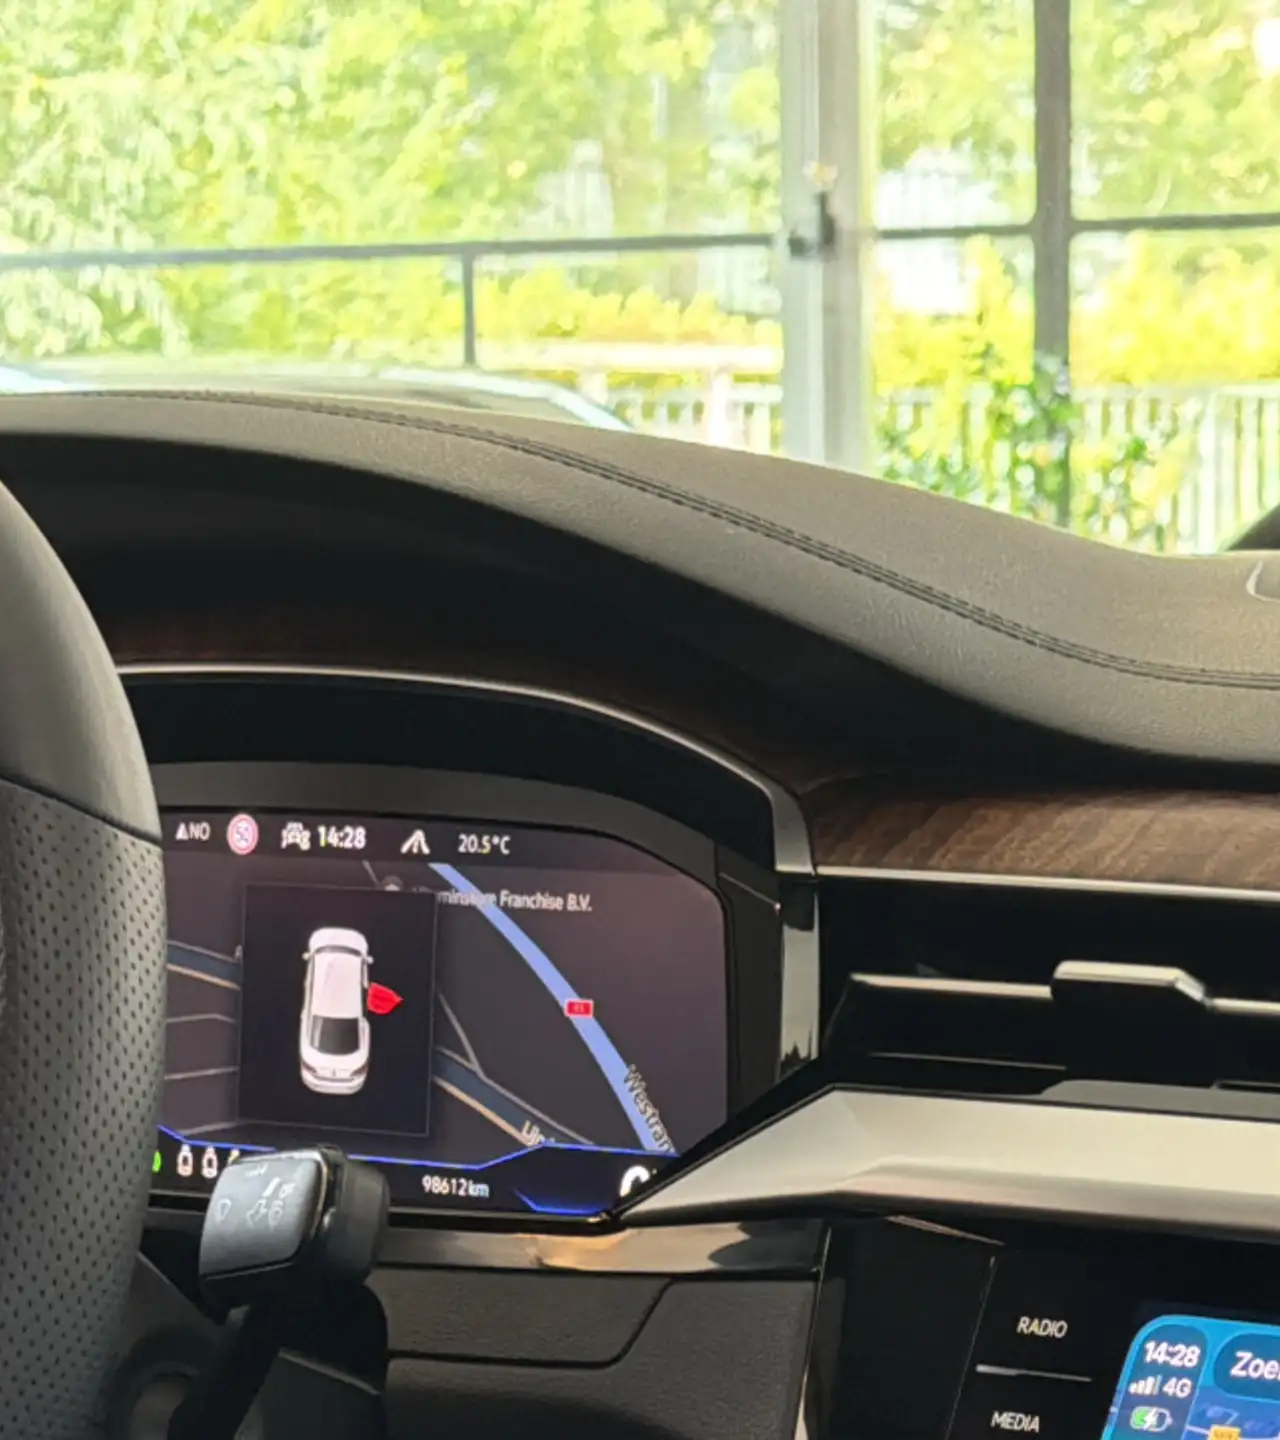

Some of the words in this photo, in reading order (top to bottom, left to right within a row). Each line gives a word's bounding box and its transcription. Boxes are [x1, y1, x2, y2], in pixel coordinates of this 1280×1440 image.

[318, 824, 367, 849] 14:28
[499, 889, 563, 911] Franchise
[566, 892, 593, 912] B.V.
[1016, 1315, 1068, 1339] RADIO
[1143, 1340, 1202, 1368] 14:28
[1162, 1377, 1192, 1398] 4G
[990, 1411, 1040, 1433] MEDIA
